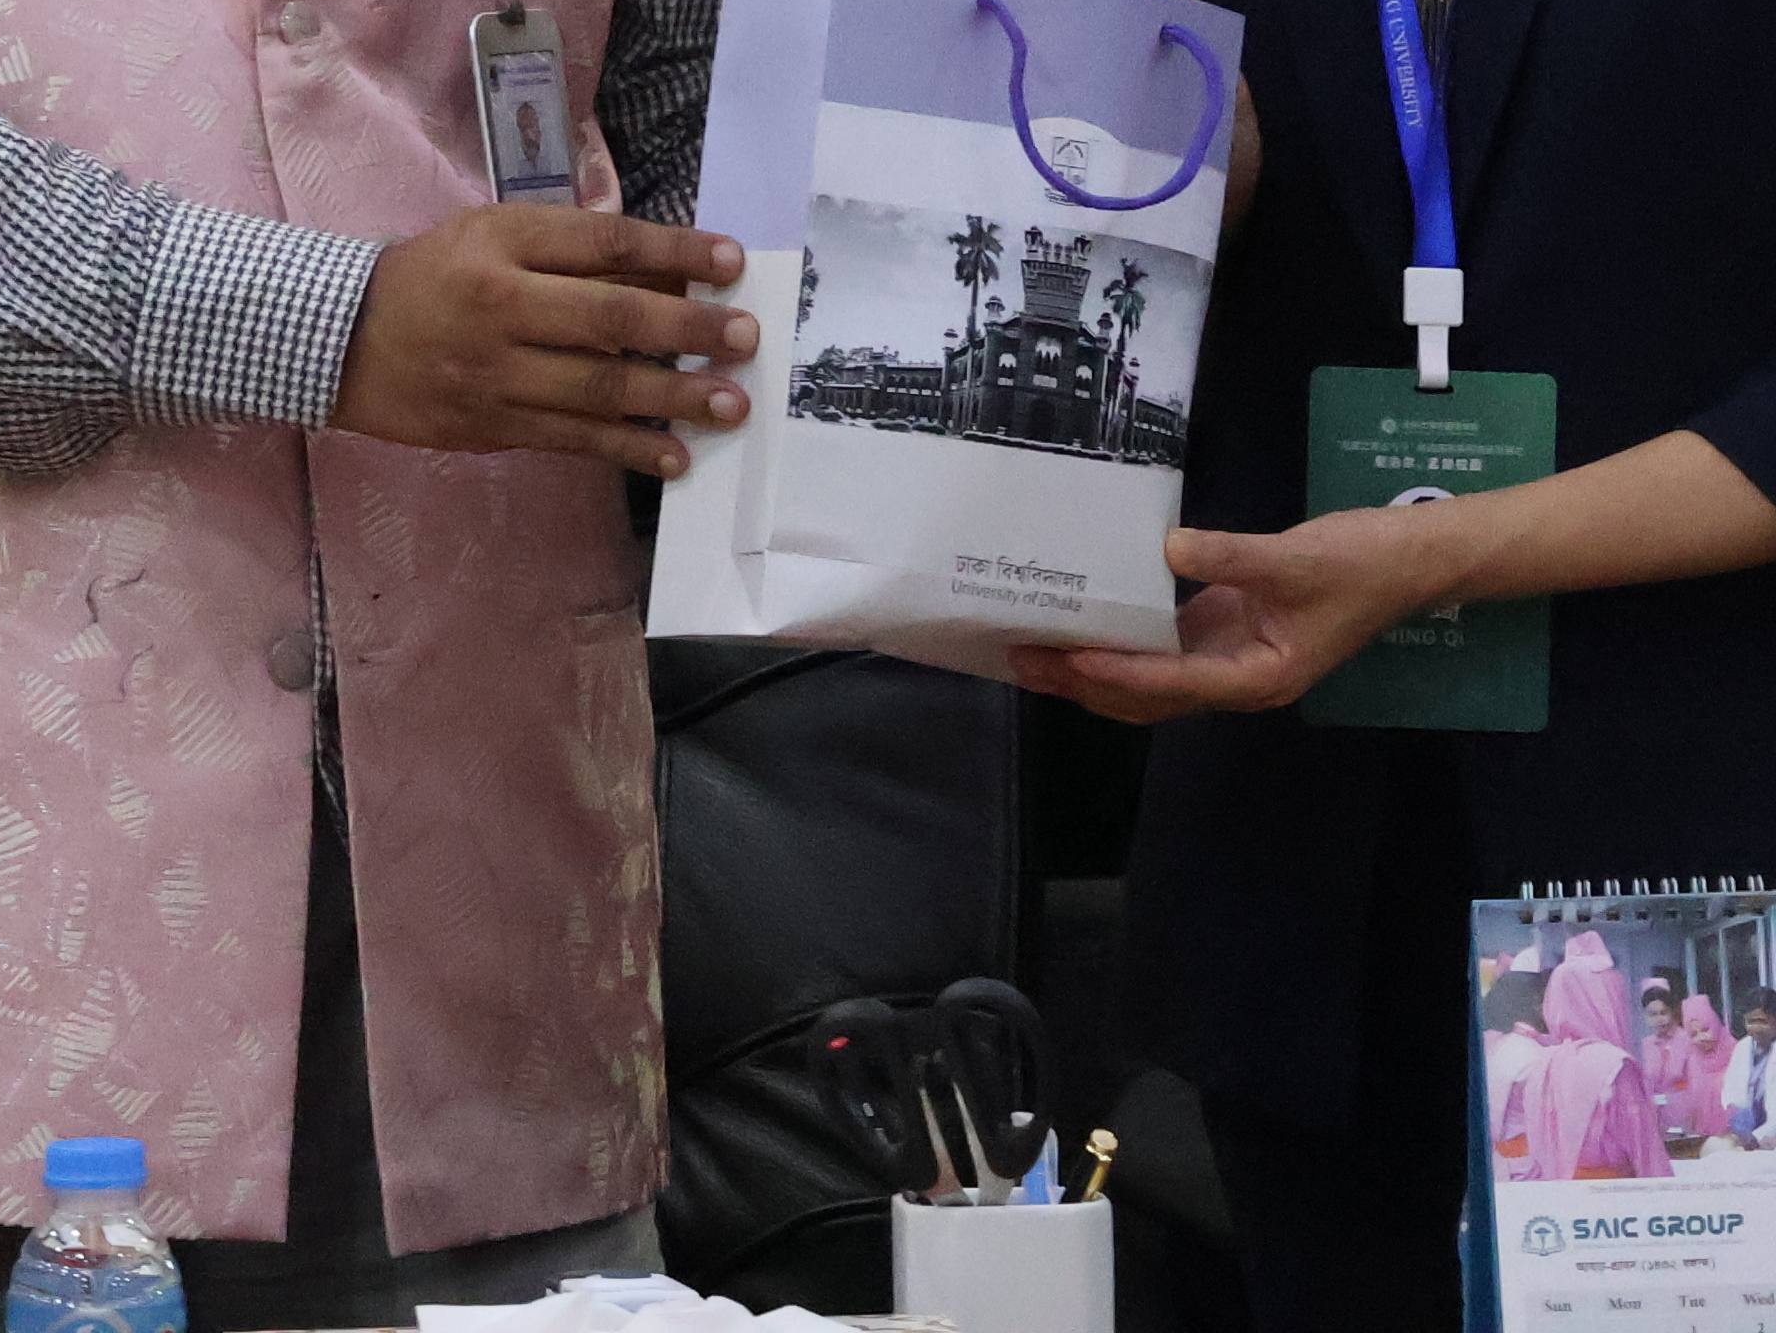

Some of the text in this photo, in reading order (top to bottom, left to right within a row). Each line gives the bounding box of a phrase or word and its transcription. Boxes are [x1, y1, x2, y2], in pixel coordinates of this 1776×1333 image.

[951, 579, 1083, 613] University of Dhaka
[1573, 1216, 1639, 1240] SAIC
[1647, 1213, 1744, 1238] GROUP
[1545, 1299, 1573, 1313] Sun
[1608, 1297, 1642, 1311] Mon
[1679, 1294, 1706, 1309] Tue
[1742, 1292, 1776, 1307] Wed
